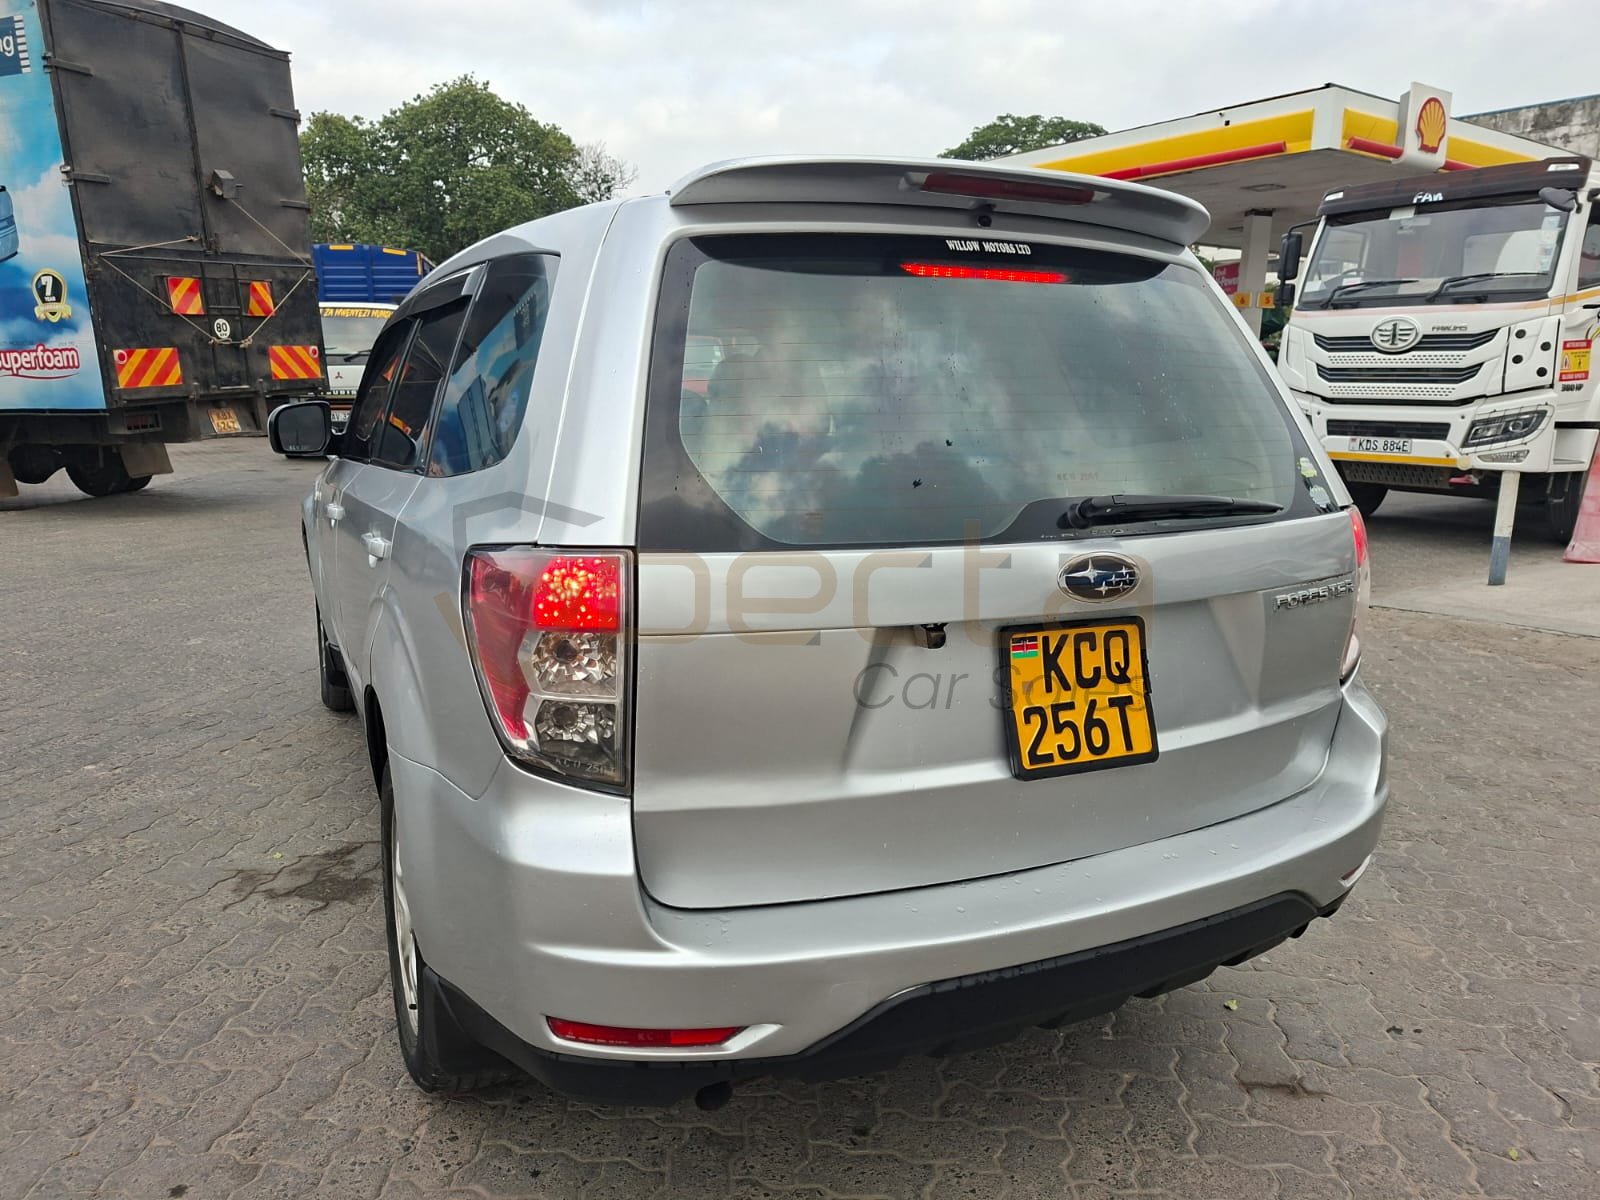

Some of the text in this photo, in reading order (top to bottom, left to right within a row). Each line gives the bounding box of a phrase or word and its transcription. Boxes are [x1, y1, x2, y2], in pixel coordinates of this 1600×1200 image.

[946, 239, 1031, 255] WILLOW MOTORS LTD
[41, 275, 53, 297] 7
[216, 322, 228, 333] 80
[0, 344, 80, 376] uperfoam
[1358, 438, 1409, 452] KDS 884E
[1273, 580, 1354, 612] FORESTER
[1041, 629, 1131, 694] KCQ
[1022, 695, 1134, 767] 256T
